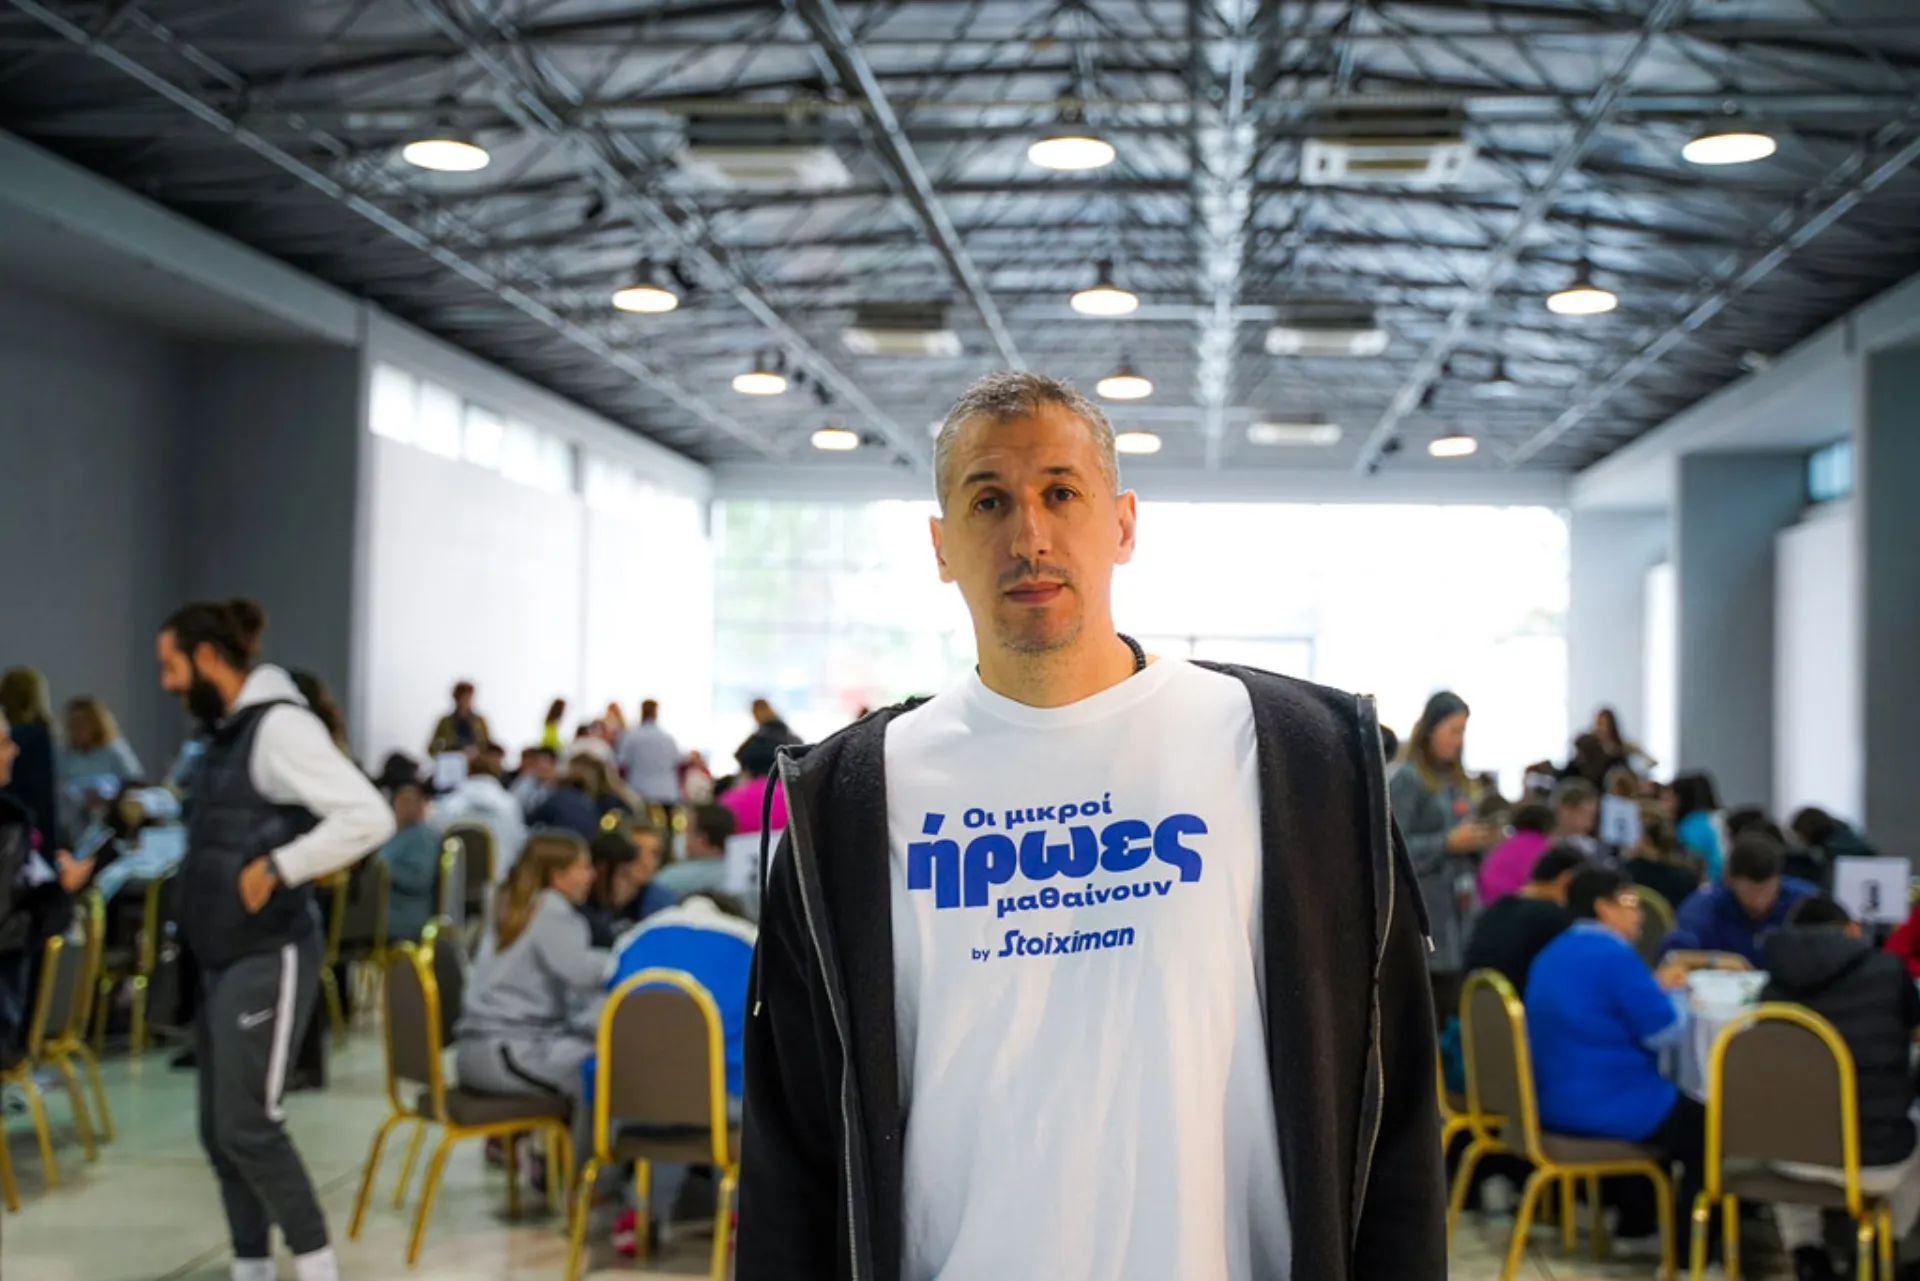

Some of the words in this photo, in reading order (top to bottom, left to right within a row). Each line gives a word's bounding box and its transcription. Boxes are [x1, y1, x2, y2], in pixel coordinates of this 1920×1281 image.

[963, 807, 996, 828] Οι
[1005, 792, 1112, 830] μικροί
[906, 813, 1208, 909] ήρωες
[996, 880, 1173, 918] μαθαίνουν
[972, 947, 990, 961] by
[998, 926, 1135, 958] Stoiximan
